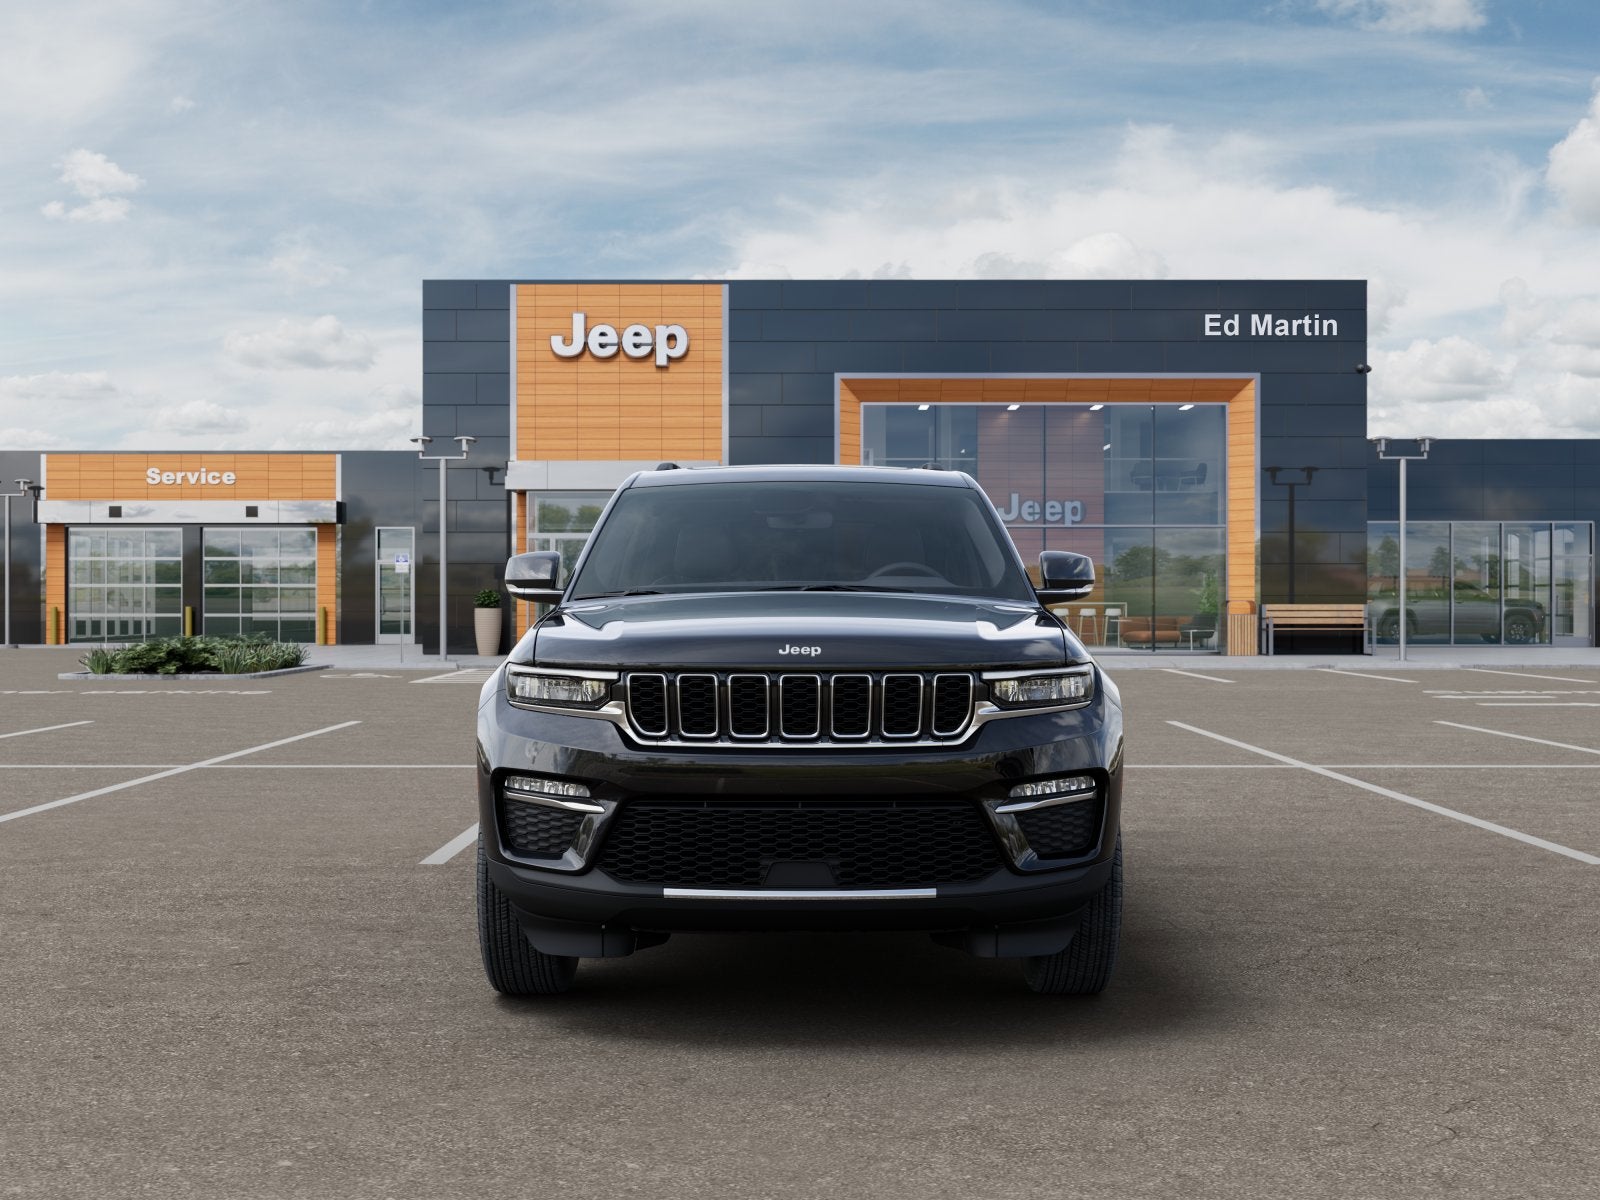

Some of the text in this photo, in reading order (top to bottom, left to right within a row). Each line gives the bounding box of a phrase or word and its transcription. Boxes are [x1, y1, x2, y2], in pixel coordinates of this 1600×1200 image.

[1204, 314, 1338, 336] Ed Martin
[550, 311, 690, 367] Jeep
[145, 467, 237, 486] Service
[997, 493, 1084, 526] Jeep
[778, 644, 822, 657] Jeep
